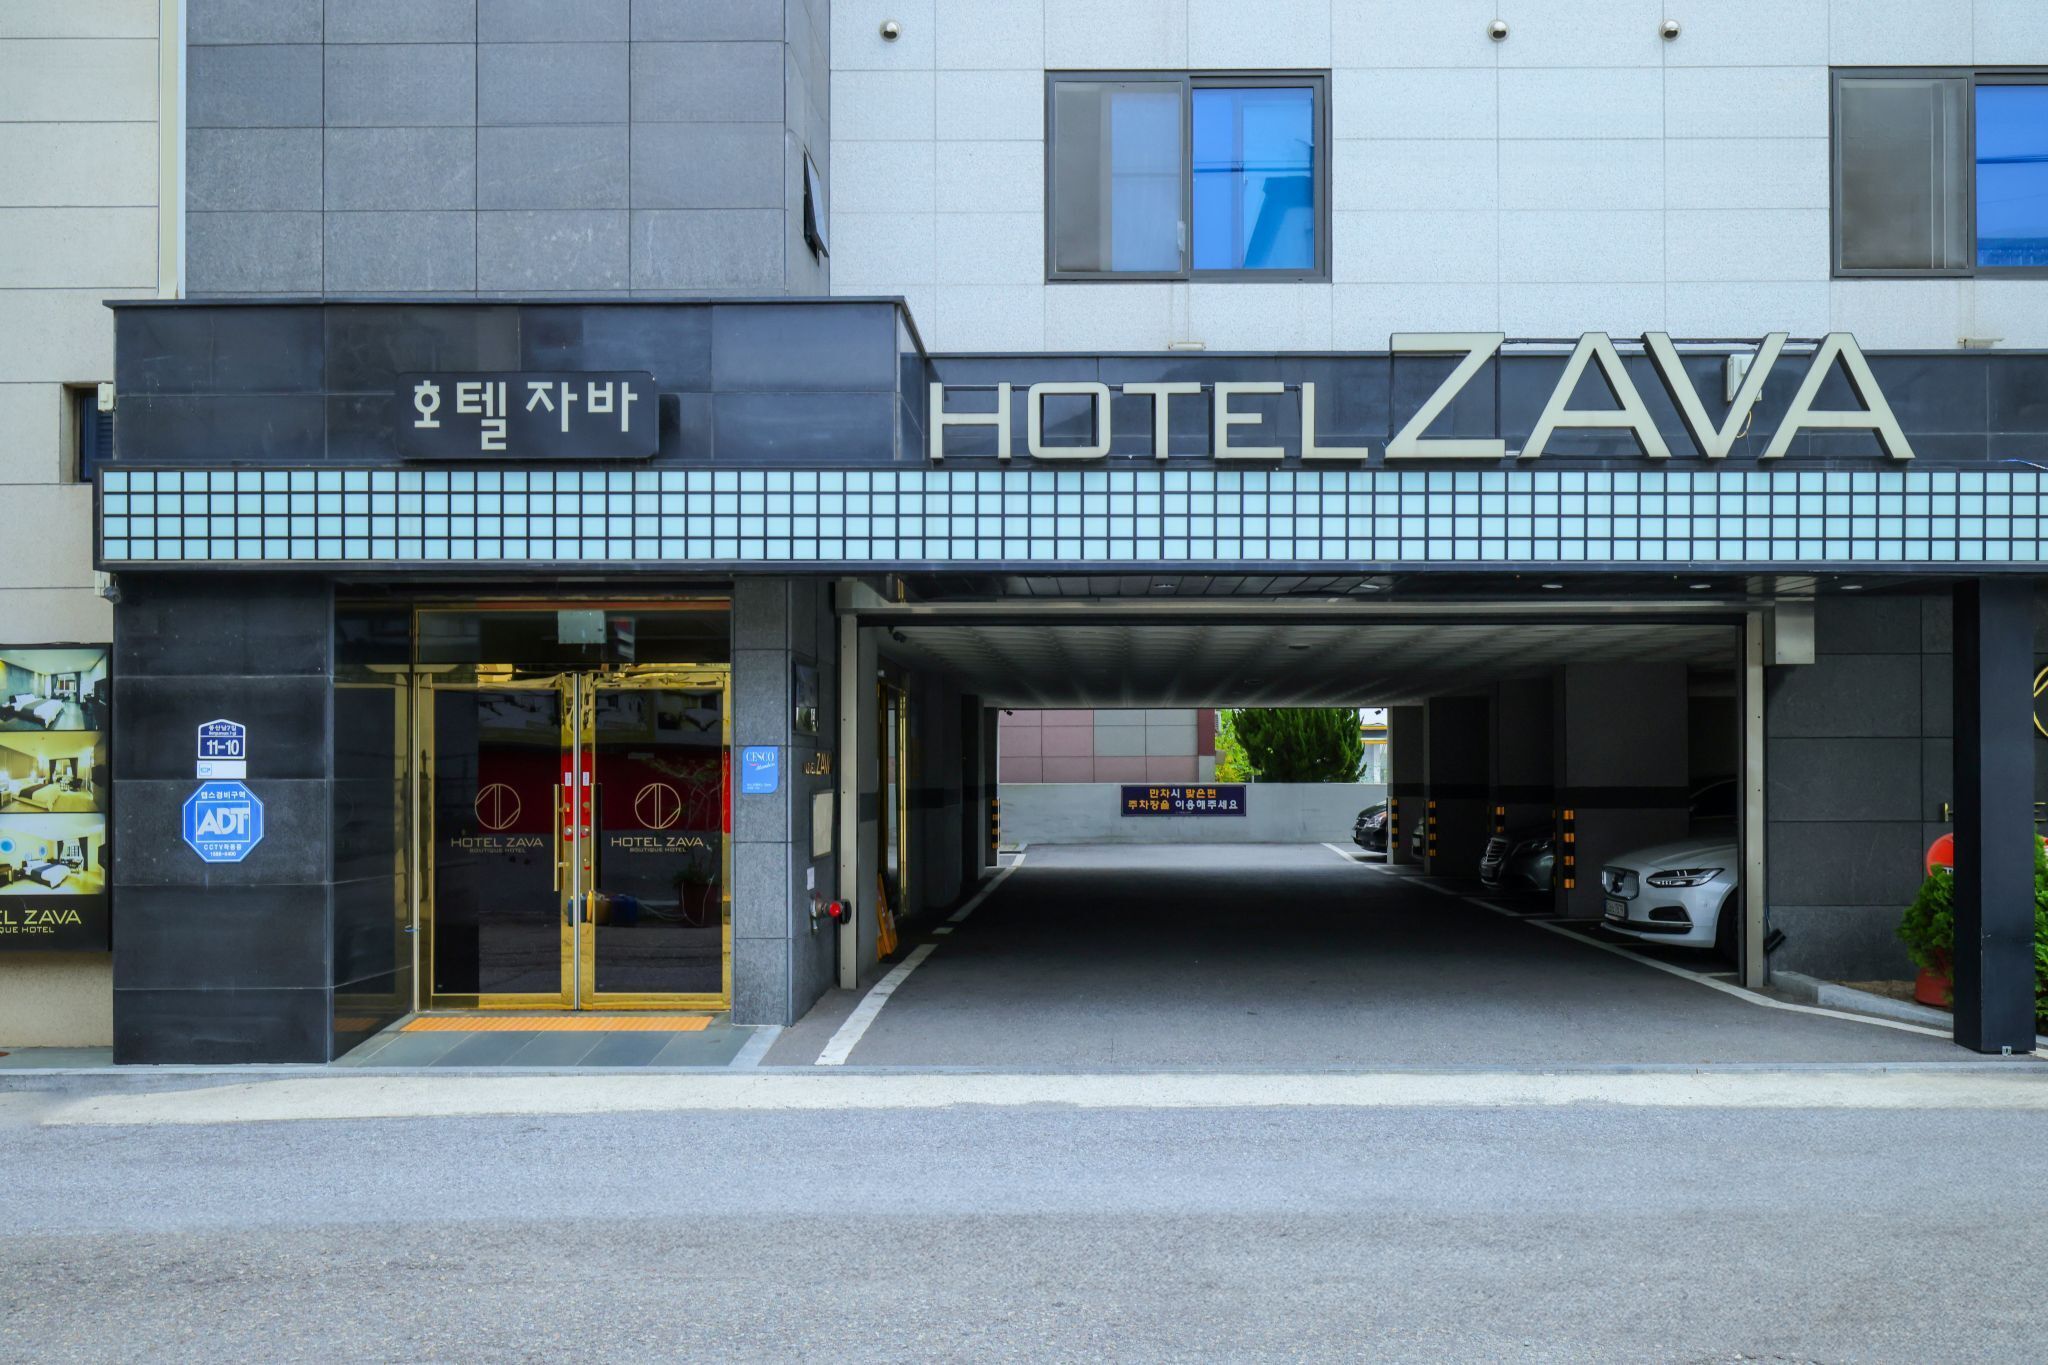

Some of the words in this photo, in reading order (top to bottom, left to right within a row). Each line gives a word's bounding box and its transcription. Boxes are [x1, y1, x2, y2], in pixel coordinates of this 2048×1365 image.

[928, 380, 1369, 460] HOTEL
[1384, 331, 1916, 461] ZAVA
[413, 380, 507, 450] 호텔
[525, 381, 638, 432] 자바
[206, 739, 240, 756] 11-10
[745, 751, 775, 763] CESCO
[815, 752, 832, 776] ZAV
[1149, 788, 1181, 799] 만차시
[1128, 799, 1170, 810] 주차장을
[1175, 799, 1239, 811] 이용해주세요
[197, 807, 250, 836] ADT
[450, 837, 502, 847] HOTEL
[506, 837, 544, 847] ZAVA
[611, 837, 662, 847] HOTEL
[666, 837, 704, 847] ZAVA
[24, 909, 82, 925] ZAVA
[21, 926, 55, 934] HOTEL
